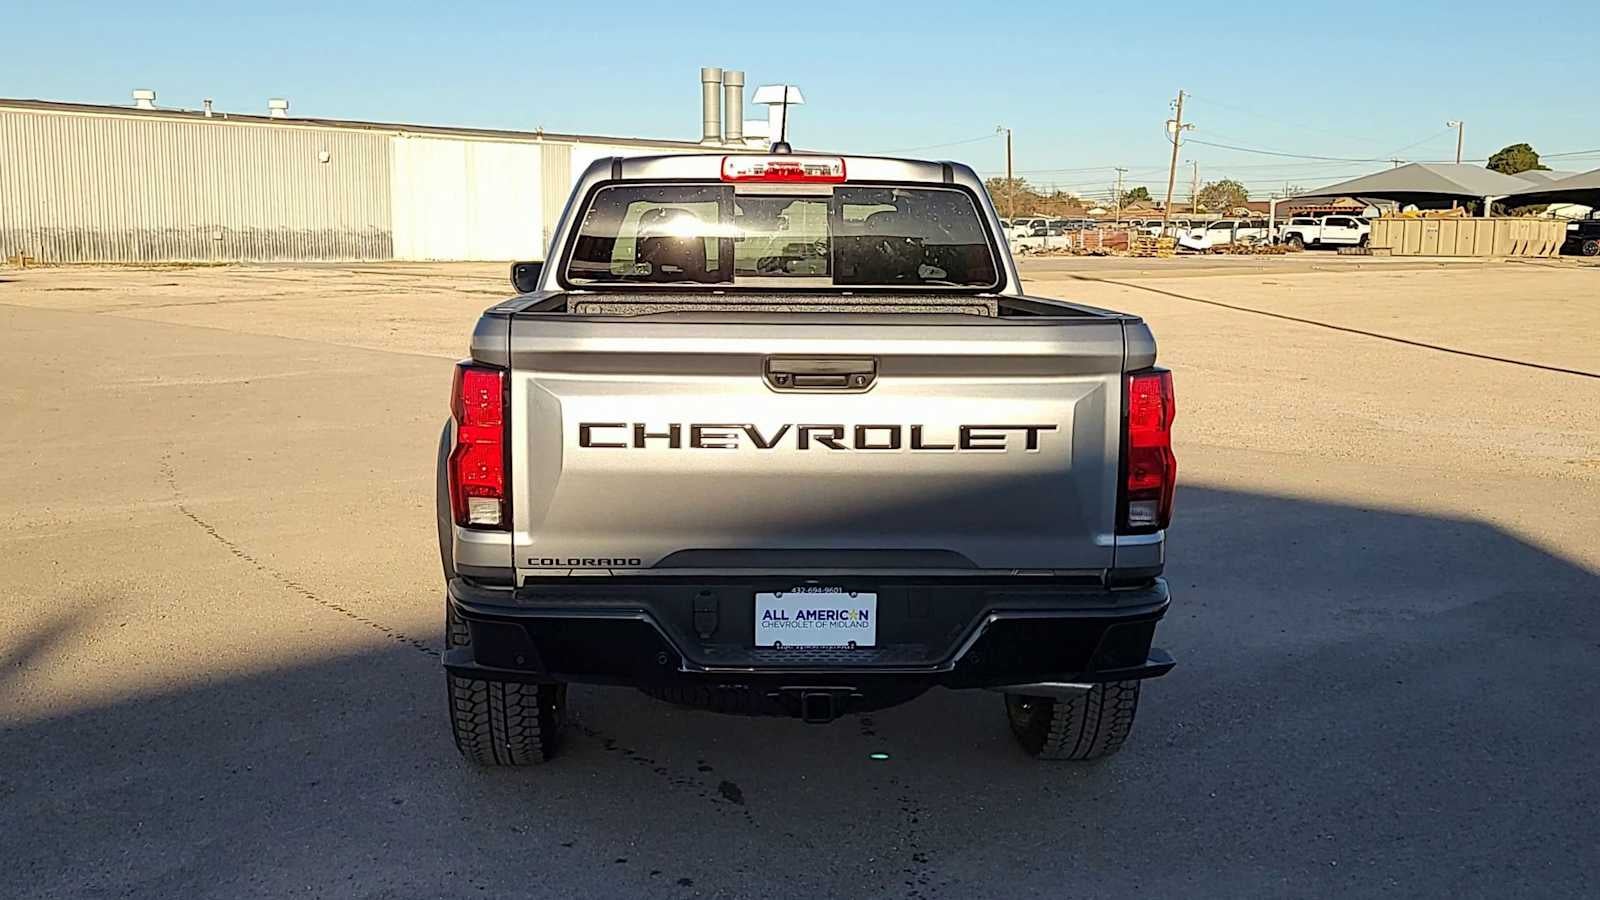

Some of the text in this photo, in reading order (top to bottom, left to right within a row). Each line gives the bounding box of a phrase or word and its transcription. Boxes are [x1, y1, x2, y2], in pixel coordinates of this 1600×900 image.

[579, 423, 1058, 450] CHEVROLET
[527, 558, 641, 566] COLORADO
[763, 609, 789, 620] ALL
[761, 621, 869, 629] CHEVROLET OF MIDLAND
